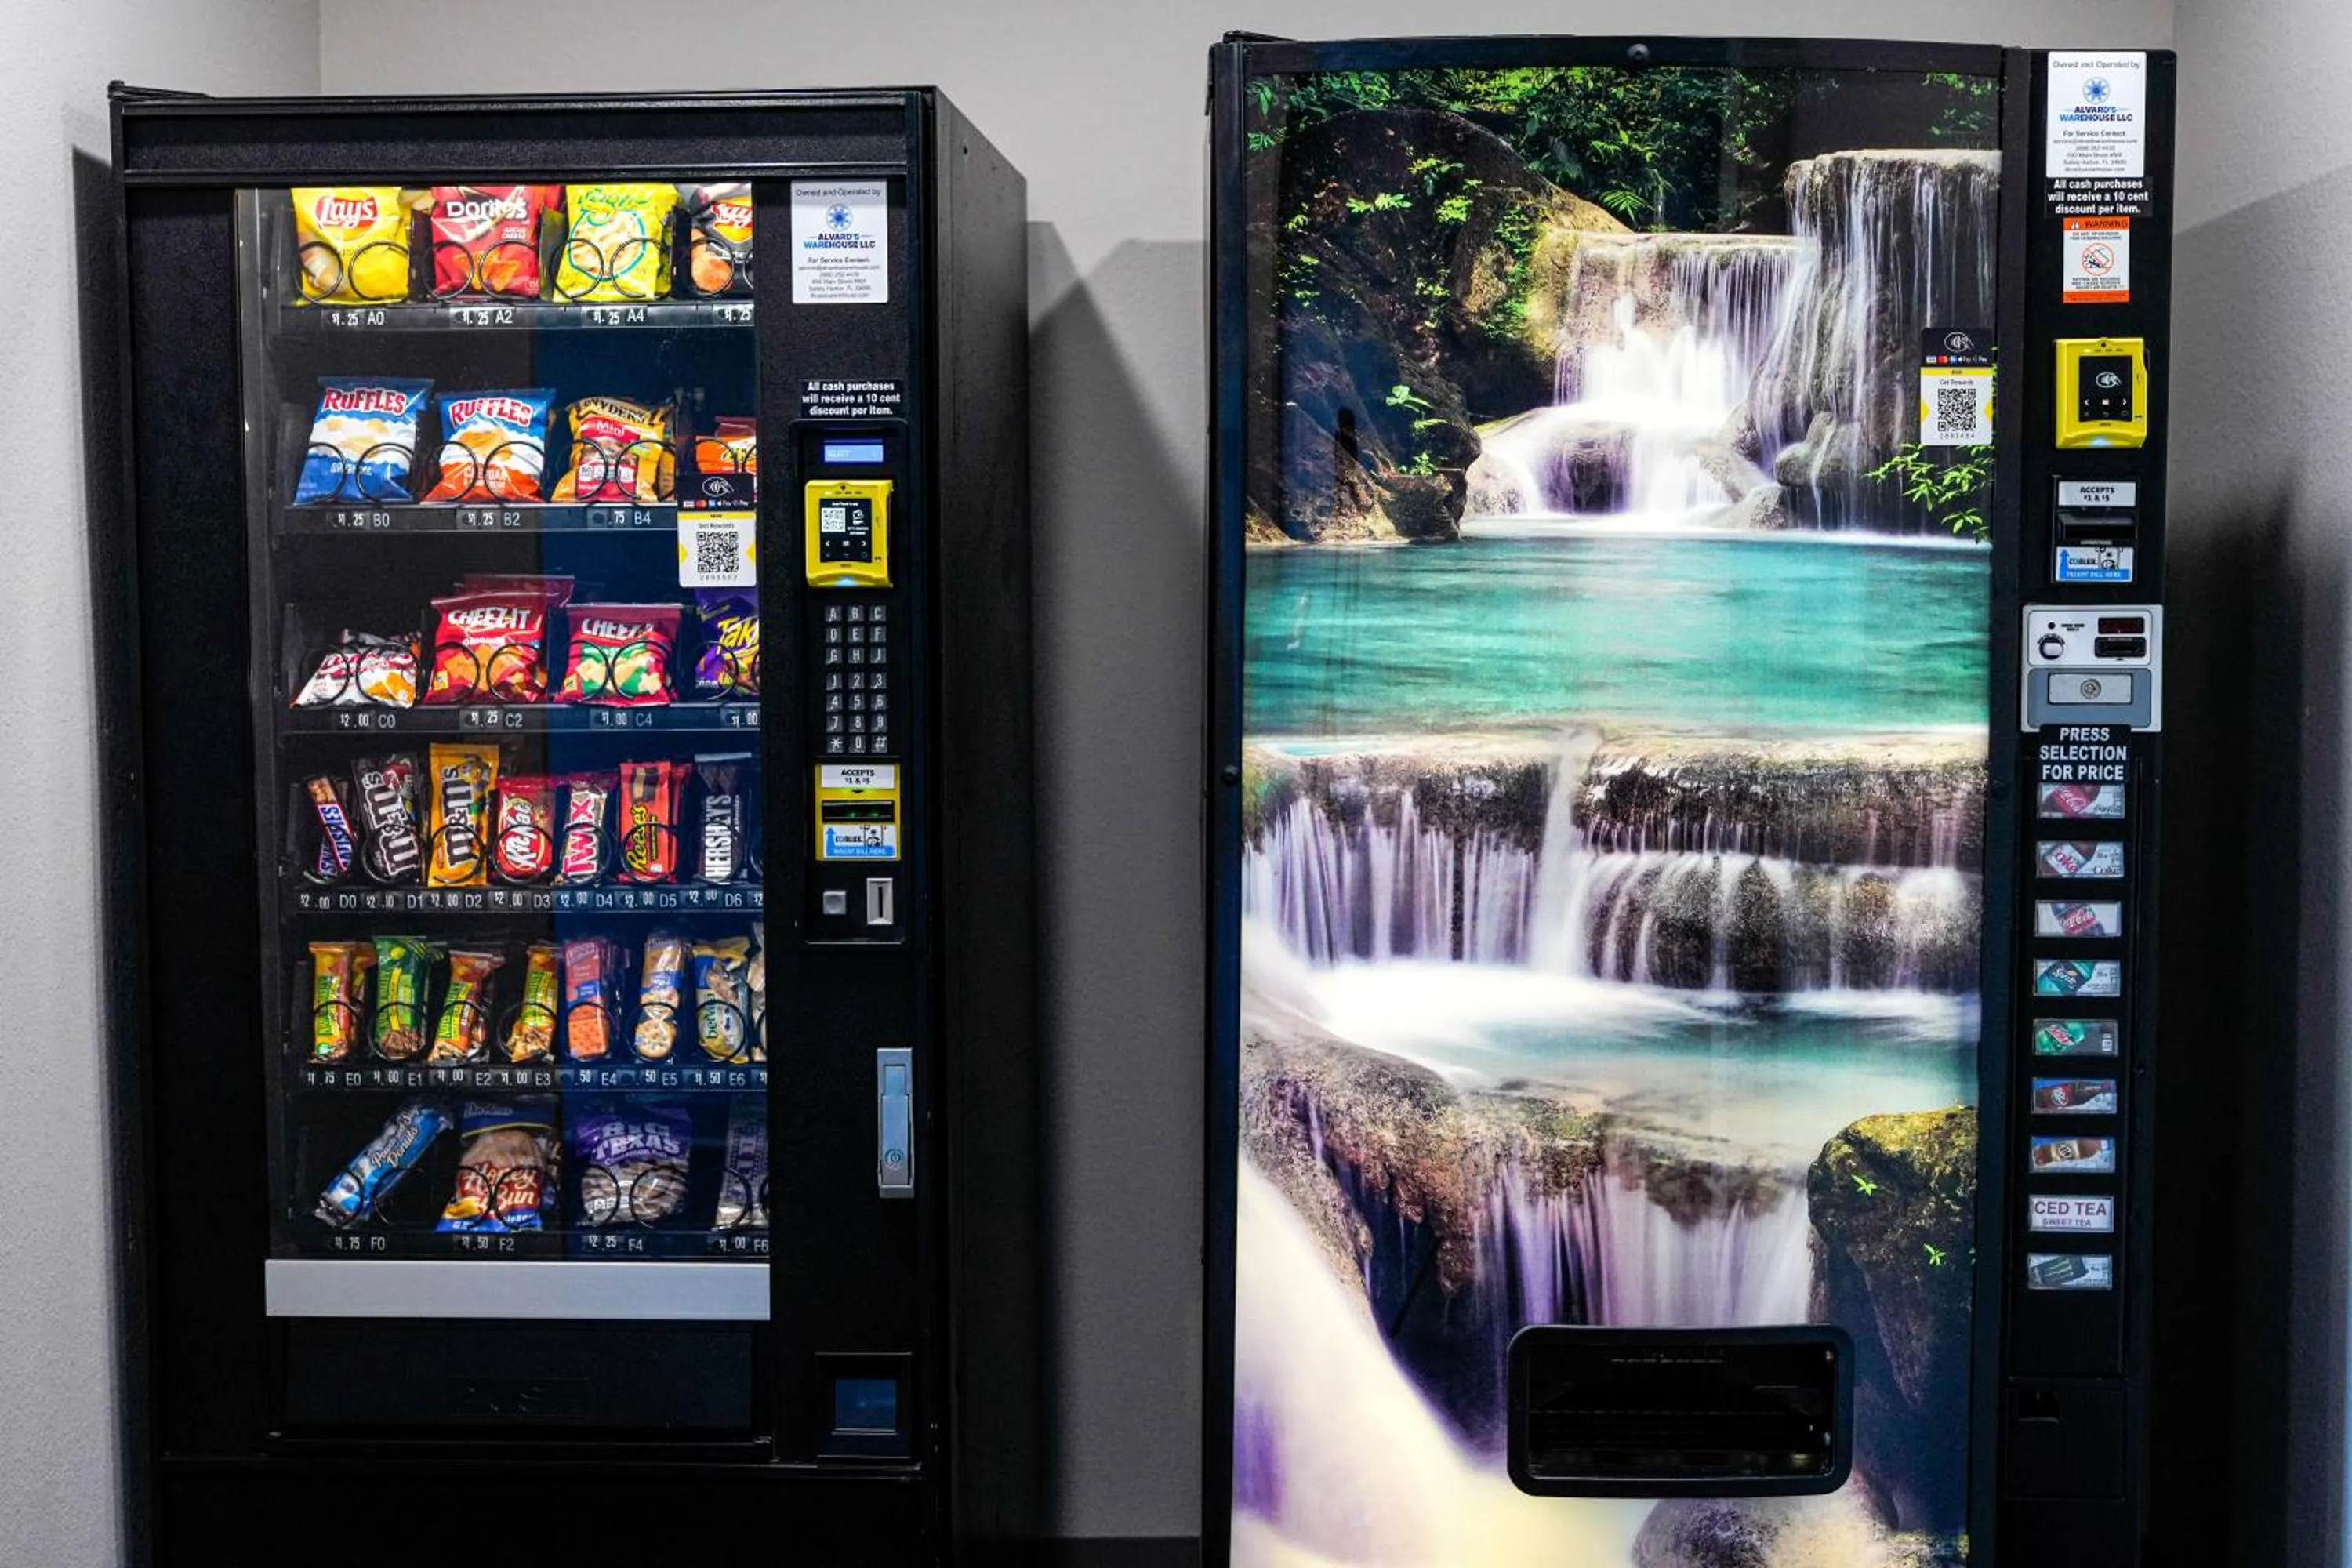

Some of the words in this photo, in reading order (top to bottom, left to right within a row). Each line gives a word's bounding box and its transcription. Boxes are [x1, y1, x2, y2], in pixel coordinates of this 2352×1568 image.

[2054, 180, 2066, 189] All
[2069, 180, 2092, 189] cash
[2094, 180, 2143, 191] purchases
[837, 188, 871, 197] Operated
[2048, 192, 2063, 201] will
[2067, 192, 2101, 201] receive
[2114, 192, 2125, 201] 10
[2128, 192, 2148, 201] cent
[2056, 205, 2095, 214] discount
[2098, 206, 2114, 215] per
[2117, 205, 2140, 213] item.
[495, 310, 513, 324] A2
[627, 309, 644, 322] A4
[808, 381, 820, 390] All
[822, 381, 844, 391] cash
[847, 381, 895, 392] purchases
[323, 388, 407, 415] RUFFLES
[802, 394, 818, 403] will
[821, 394, 855, 403] receive
[866, 394, 877, 402] 10
[879, 394, 900, 402] cent
[450, 398, 534, 427] RUFFLES
[809, 405, 849, 415] discount
[851, 407, 867, 416] per
[869, 405, 893, 415] item.
[373, 514, 390, 527] B0
[504, 513, 521, 526] B2
[634, 512, 652, 525] B4
[506, 713, 523, 727] C2
[636, 712, 653, 727] C4
[2060, 728, 2110, 741] PRESS
[2039, 746, 2127, 760] SELECTION
[2042, 765, 2074, 780] FOR
[2078, 765, 2124, 780] PRICE
[407, 895, 422, 909] D1
[466, 895, 482, 908] D2
[534, 895, 550, 908] D3
[596, 894, 612, 907] D4
[660, 894, 677, 907] D5
[725, 893, 742, 906] D6
[408, 1072, 423, 1085] E1
[476, 1072, 492, 1085] E2
[535, 1072, 551, 1085] E3
[601, 1072, 617, 1085] E4
[662, 1072, 678, 1085] E5
[729, 1072, 746, 1085] E6
[593, 1134, 680, 1160] TEXAS
[2074, 1202, 2107, 1215] TEA
[499, 1238, 515, 1251] F2
[628, 1239, 644, 1251] F4
[754, 1239, 768, 1252] F6
